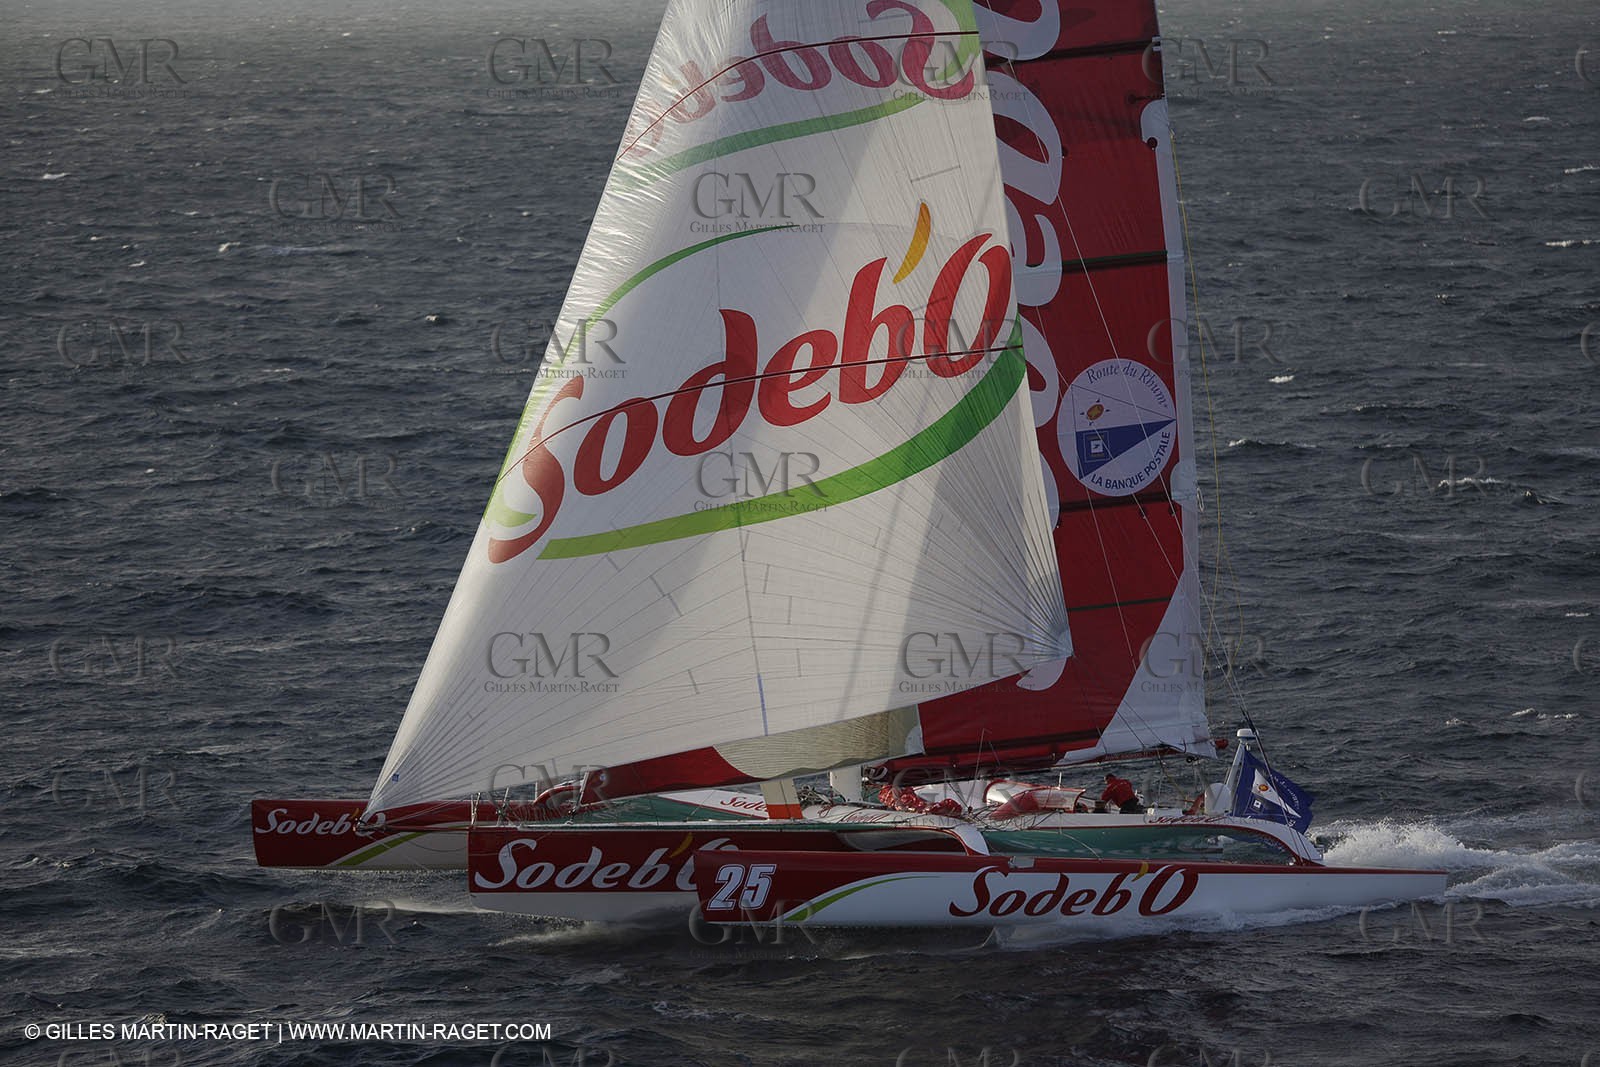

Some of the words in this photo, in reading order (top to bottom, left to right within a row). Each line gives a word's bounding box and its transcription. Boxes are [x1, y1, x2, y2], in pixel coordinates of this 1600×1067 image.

[488, 202, 1012, 564] Sodeb'O
[1086, 364, 1120, 385] Route
[1122, 361, 1138, 377] du
[1090, 473, 1103, 488] LA
[1105, 472, 1146, 489] BANQUE
[1144, 431, 1171, 476] POSTALE
[720, 796, 768, 812] Sode
[707, 863, 777, 911] 25
[949, 861, 1199, 917] Sodeb'O
